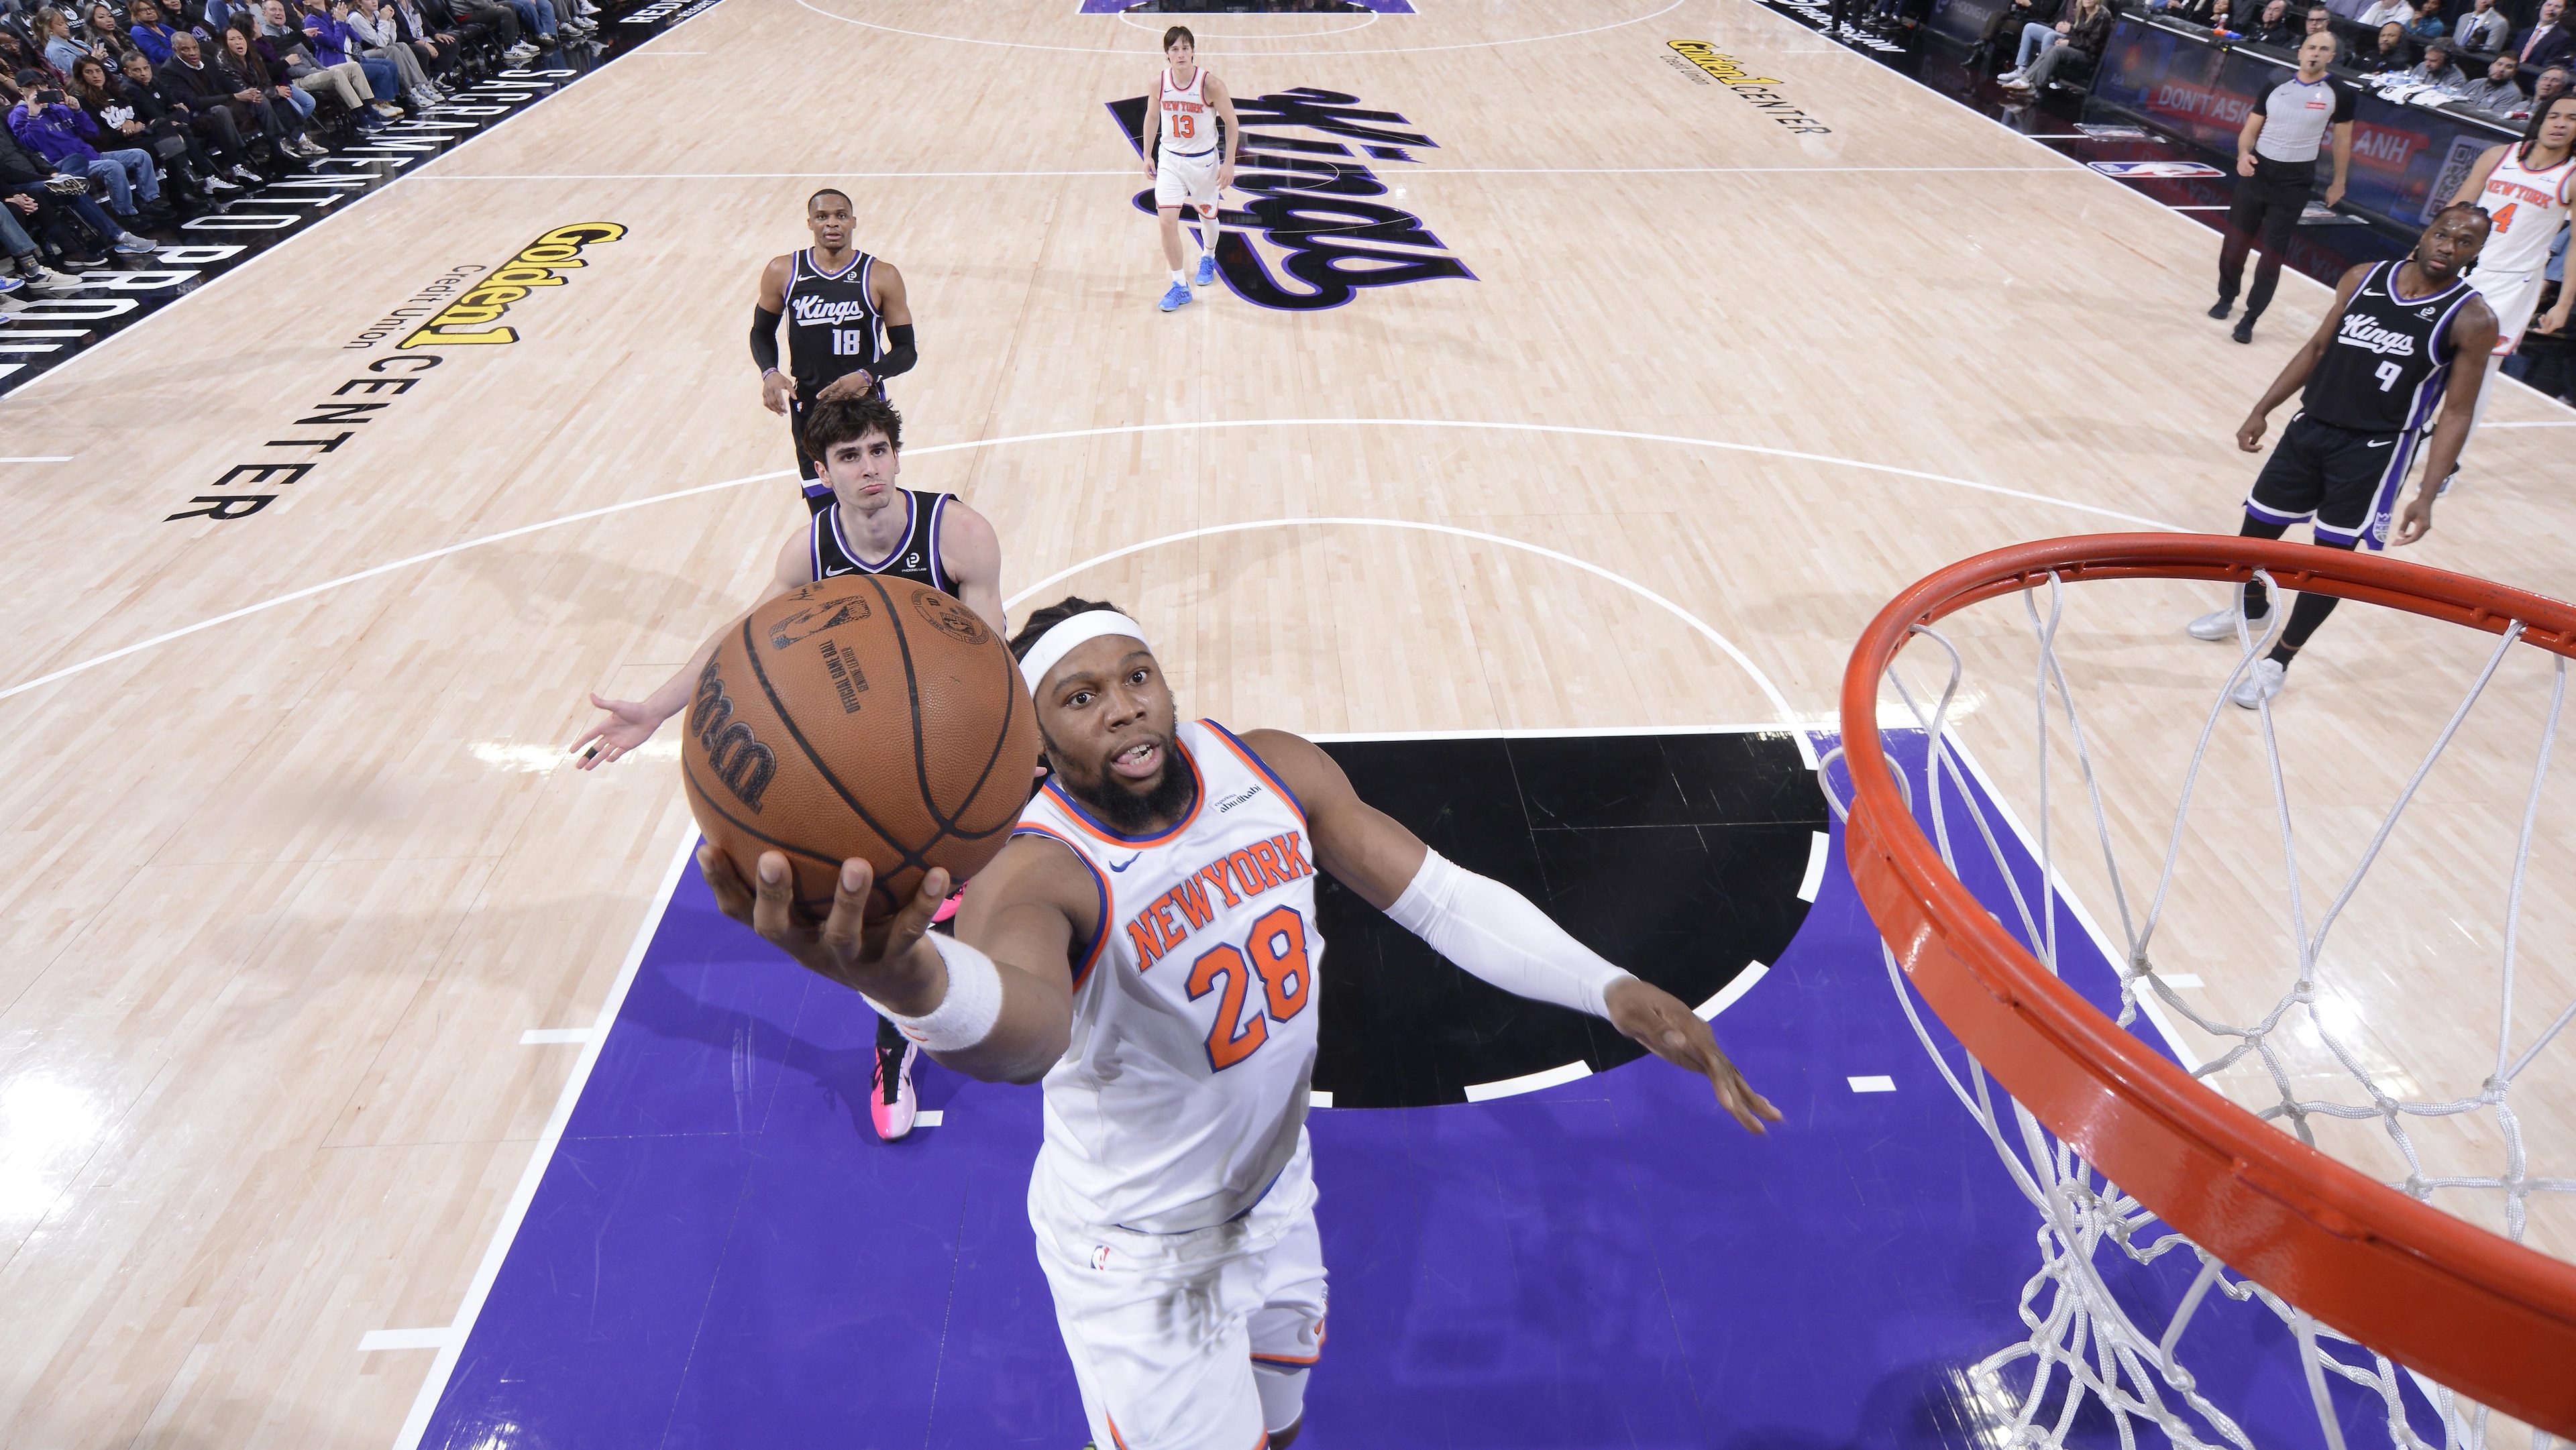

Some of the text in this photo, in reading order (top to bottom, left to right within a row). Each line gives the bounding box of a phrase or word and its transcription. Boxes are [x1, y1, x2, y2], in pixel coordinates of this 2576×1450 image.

[1162, 101, 1204, 113] NEW YORK
[1172, 115, 1195, 138] 13
[1730, 87, 1833, 133] CENTER
[2158, 85, 2255, 127] DON'T ASK
[2353, 130, 2410, 164] ANH
[2487, 179, 2555, 209] NEW YORK
[0, 68, 577, 380] SACRAMENTO PROU
[2491, 203, 2518, 233] 4
[342, 264, 488, 349] Credit Union
[792, 295, 864, 327] Kings
[832, 329, 861, 355] 18
[2338, 313, 2415, 356] Kings
[2374, 360, 2403, 392] 9
[162, 355, 443, 522] CENTER
[818, 639, 861, 714] OFFICIAL GAME BALL
[841, 646, 869, 693] GENUINE LEATHER
[1125, 830, 1314, 977] NEW YORK
[1183, 903, 1311, 1074] 28
